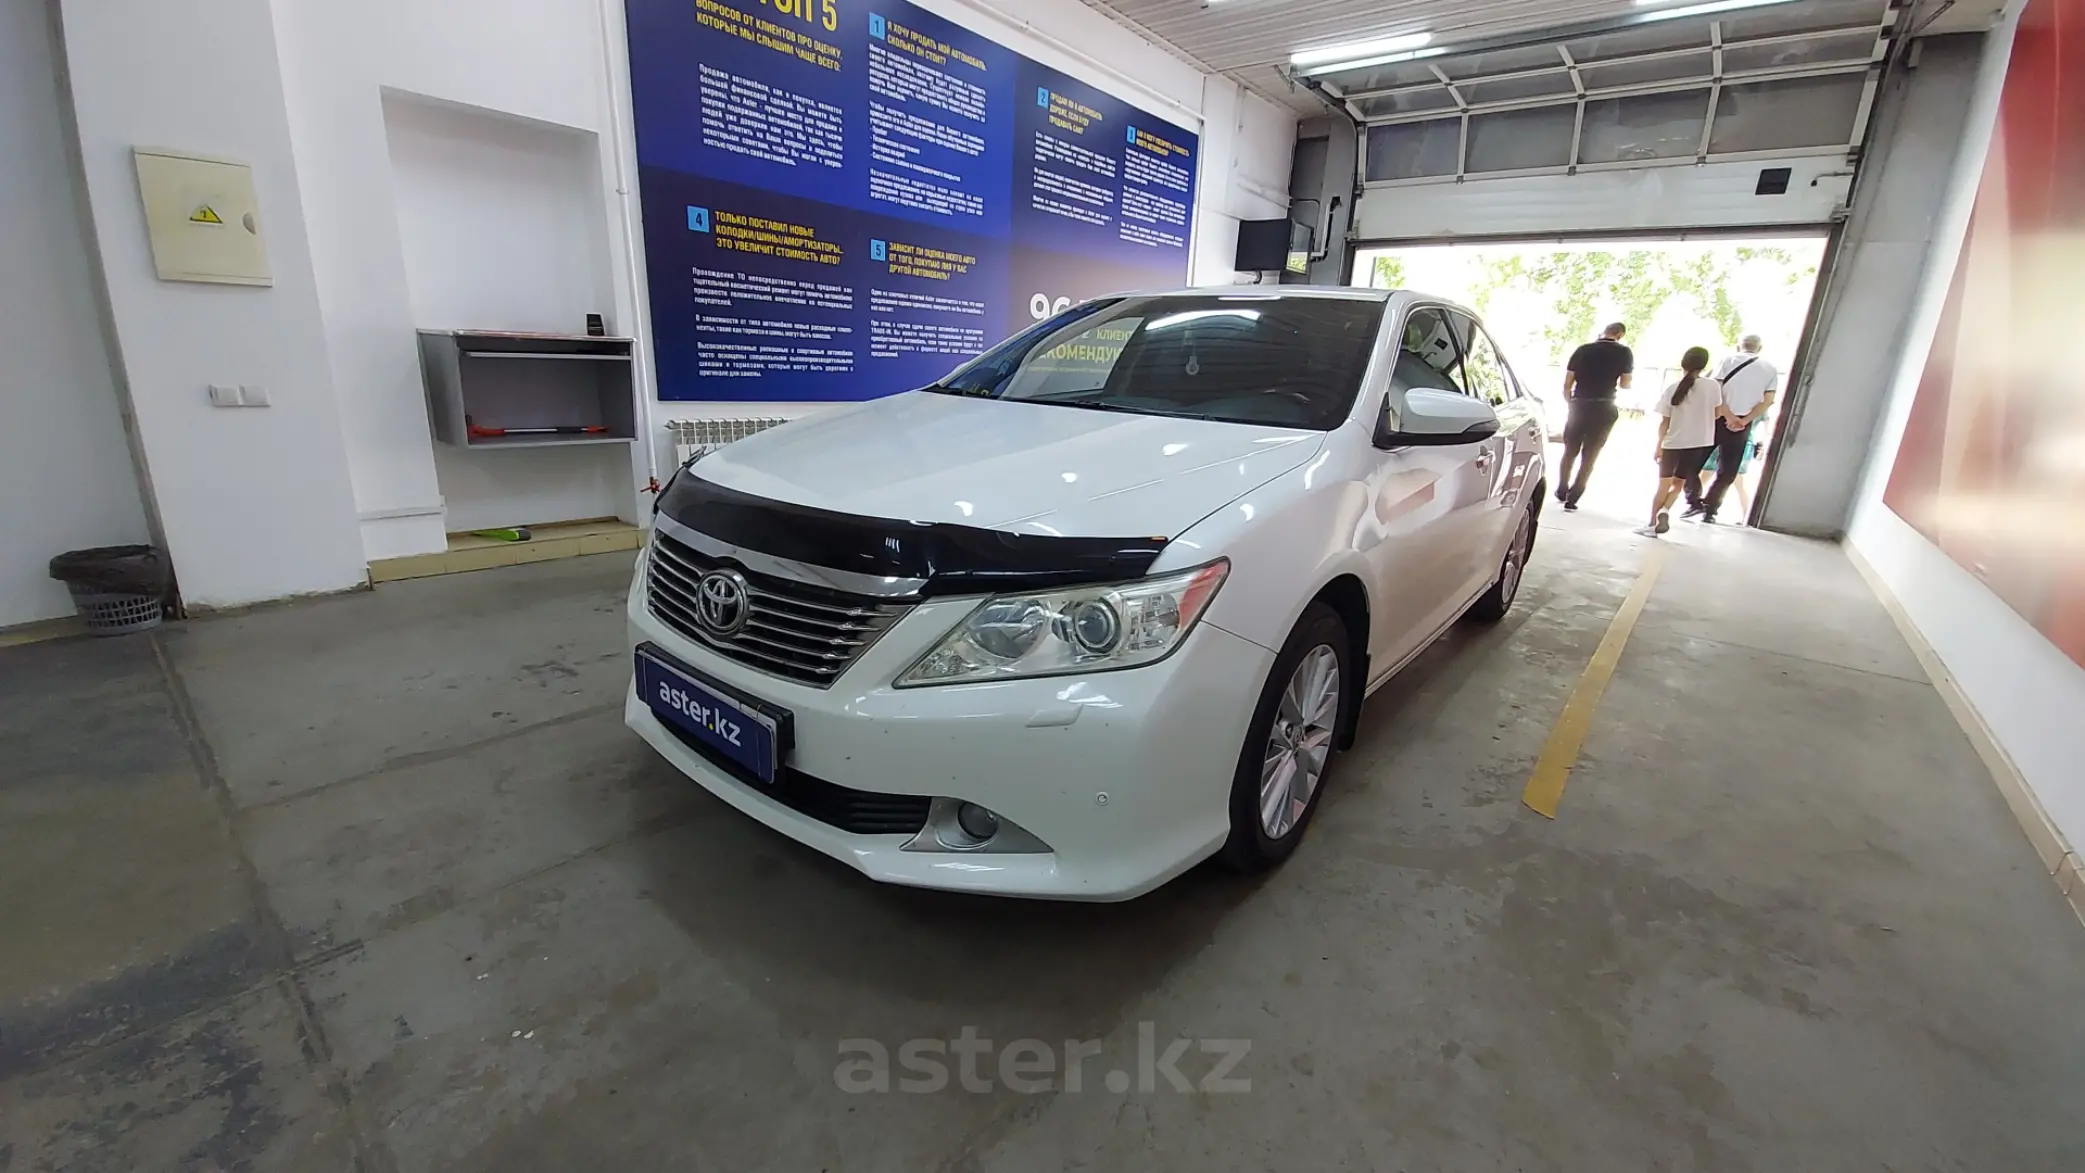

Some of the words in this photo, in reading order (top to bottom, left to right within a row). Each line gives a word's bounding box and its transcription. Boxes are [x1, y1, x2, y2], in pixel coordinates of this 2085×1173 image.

[696, 0, 741, 21] ВОПРОСОВ
[744, 14, 754, 25] ОТ
[756, 18, 795, 41] КЛИЕНТОВ
[798, 34, 812, 48] ПРО
[874, 21, 879, 33] 1
[888, 21, 892, 29] Я
[893, 23, 909, 37] ХОЧУ
[911, 31, 936, 49] ПРОДАТЬ
[938, 42, 950, 53] МОЙ
[696, 12, 737, 35] КОТОРЫЕ
[740, 26, 754, 41] МЫ
[757, 34, 793, 55] СЛЫШИМ
[796, 47, 815, 63] ЧАЩЕ
[818, 55, 841, 72] ВСЕГО:
[888, 35, 915, 53] СКОЛЬКО
[916, 47, 924, 57] ОН
[926, 50, 946, 66] СТОИТ?
[696, 213, 702, 227] 4
[715, 211, 746, 226] ТОЛЬКО
[749, 217, 788, 232] ПОСТАВИЛ
[790, 225, 814, 237] НОВЫЕ
[717, 238, 732, 248] ЭТО
[735, 241, 773, 256] УВЕЛИЧИТ
[776, 247, 818, 261] СТОИМОСТЬ
[820, 254, 840, 265] АВТО?
[876, 245, 881, 256] 5
[889, 242, 914, 254] ЗАВИСИТ
[916, 247, 923, 255] ЛИ
[925, 248, 945, 259] ОЦЕНКА
[946, 252, 962, 262] МОЕГО
[963, 255, 975, 265] АВТО
[889, 264, 911, 275] ДРУГОЙ
[1040, 344, 1123, 363] КОМЕНДУ
[659, 681, 741, 747] aster.kz
